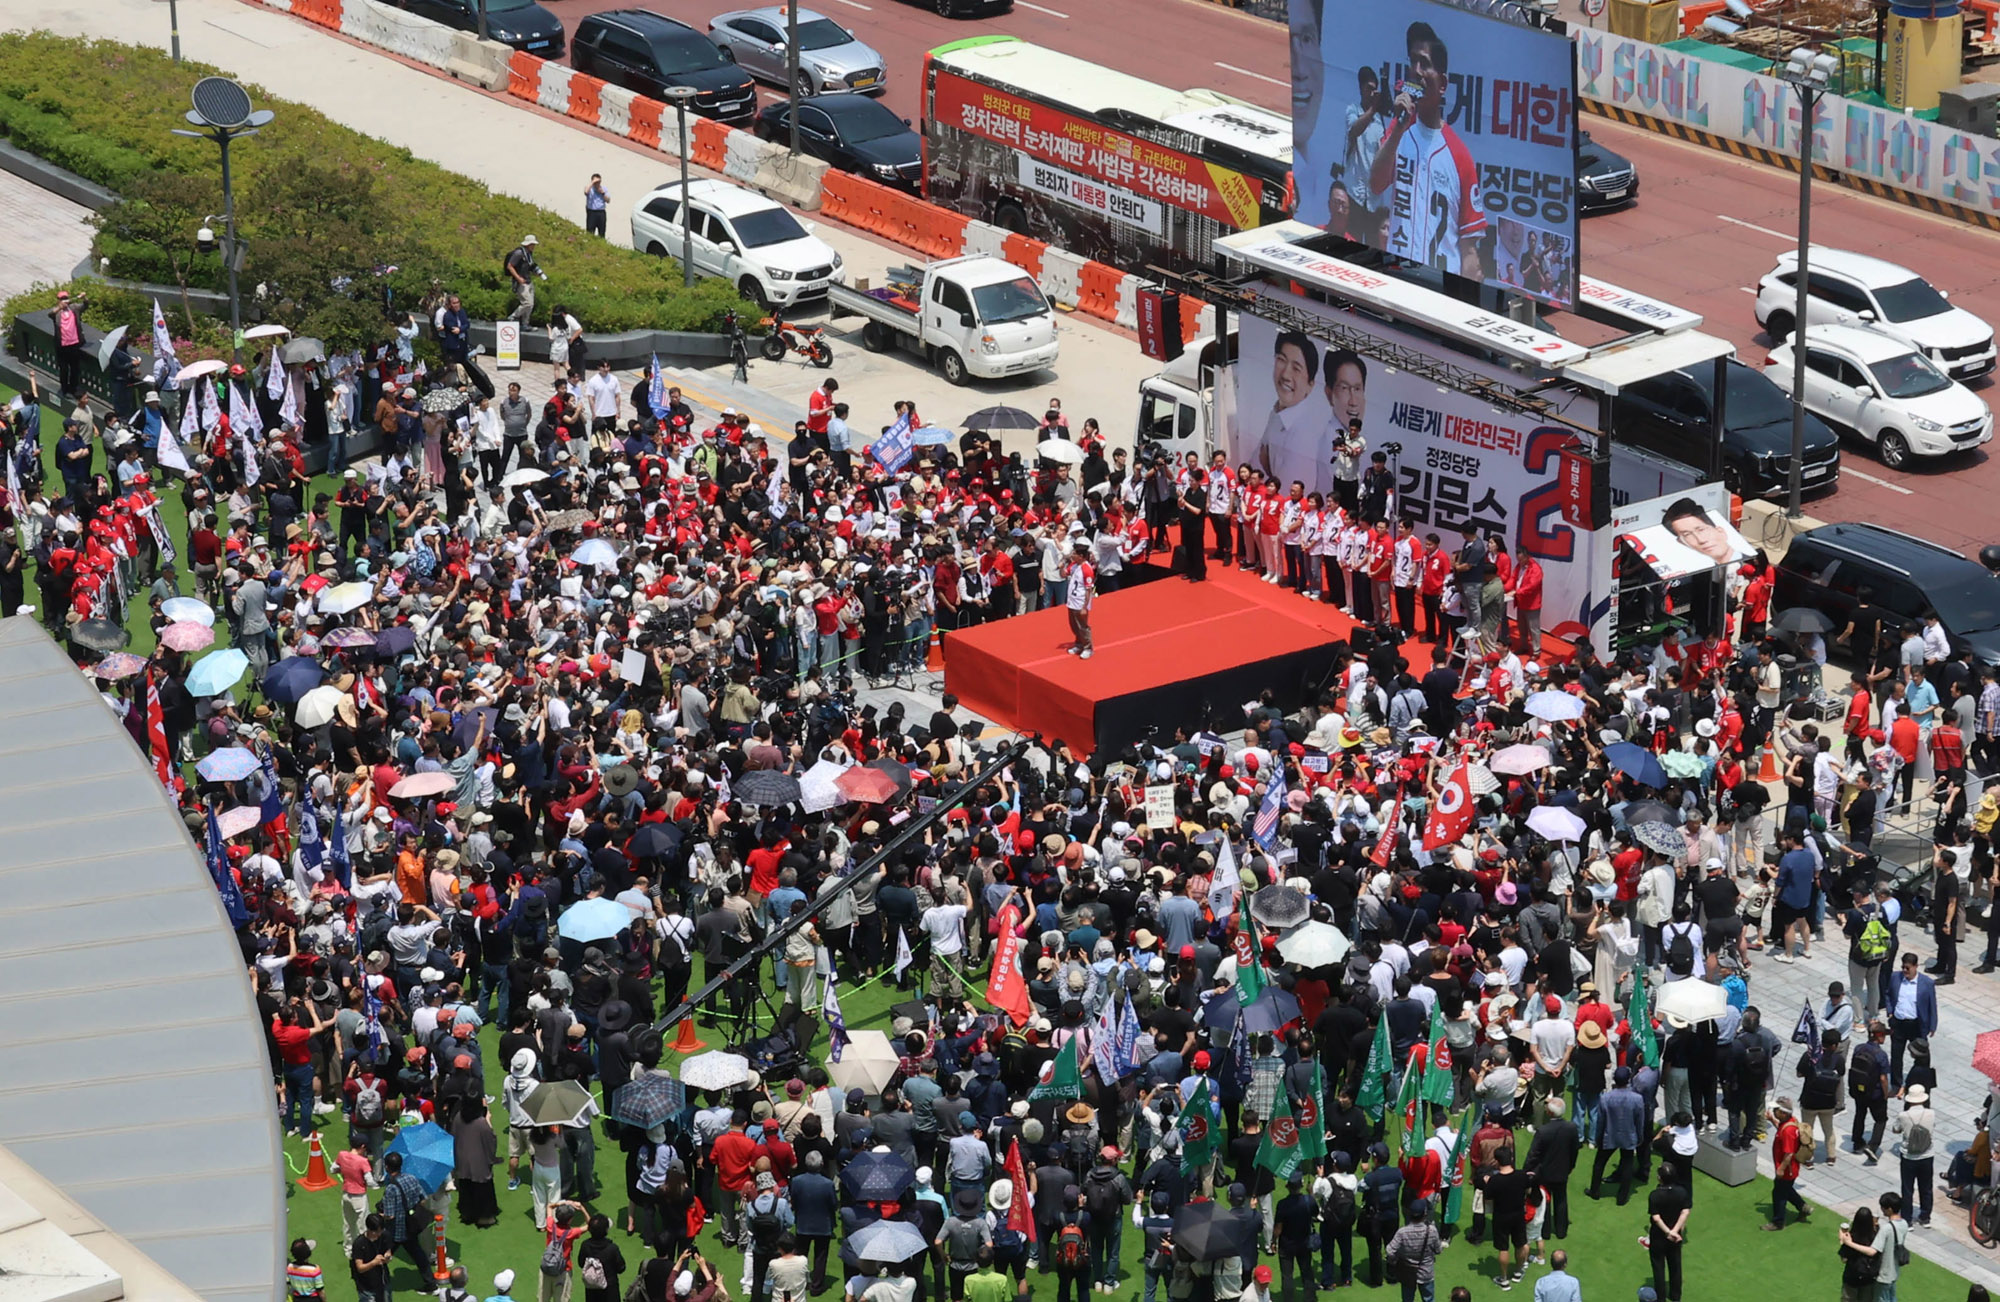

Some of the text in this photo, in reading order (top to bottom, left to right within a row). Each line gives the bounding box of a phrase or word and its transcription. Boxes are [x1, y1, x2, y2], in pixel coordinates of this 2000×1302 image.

[1013, 104, 1032, 121] 대표
[1063, 121, 1103, 146] 사법방탄
[1144, 148, 1187, 175] 규탄한다!
[961, 103, 1208, 210] 정치권력 눈치재판 사법부 각성하라!
[1034, 166, 1145, 223] 범죄자 대통령 안된다
[1392, 154, 1415, 251] 김문수
[1305, 261, 1389, 289] 대한민국!
[1464, 317, 1563, 353] 김문수 2
[1389, 401, 1522, 456] 새롭게 대한민국!
[1426, 446, 1480, 478] 정정당당
[1216, 484, 1224, 501] 2
[1570, 459, 1580, 500] 김문수
[1399, 465, 1508, 542] 김문수
[1571, 504, 1580, 522] 2
[1308, 527, 1316, 542] 2
[1329, 527, 1338, 542] 2
[1358, 544, 1365, 560] 2
[1376, 545, 1384, 559] 2
[1401, 556, 1409, 572] 2
[1432, 558, 1440, 571] 2
